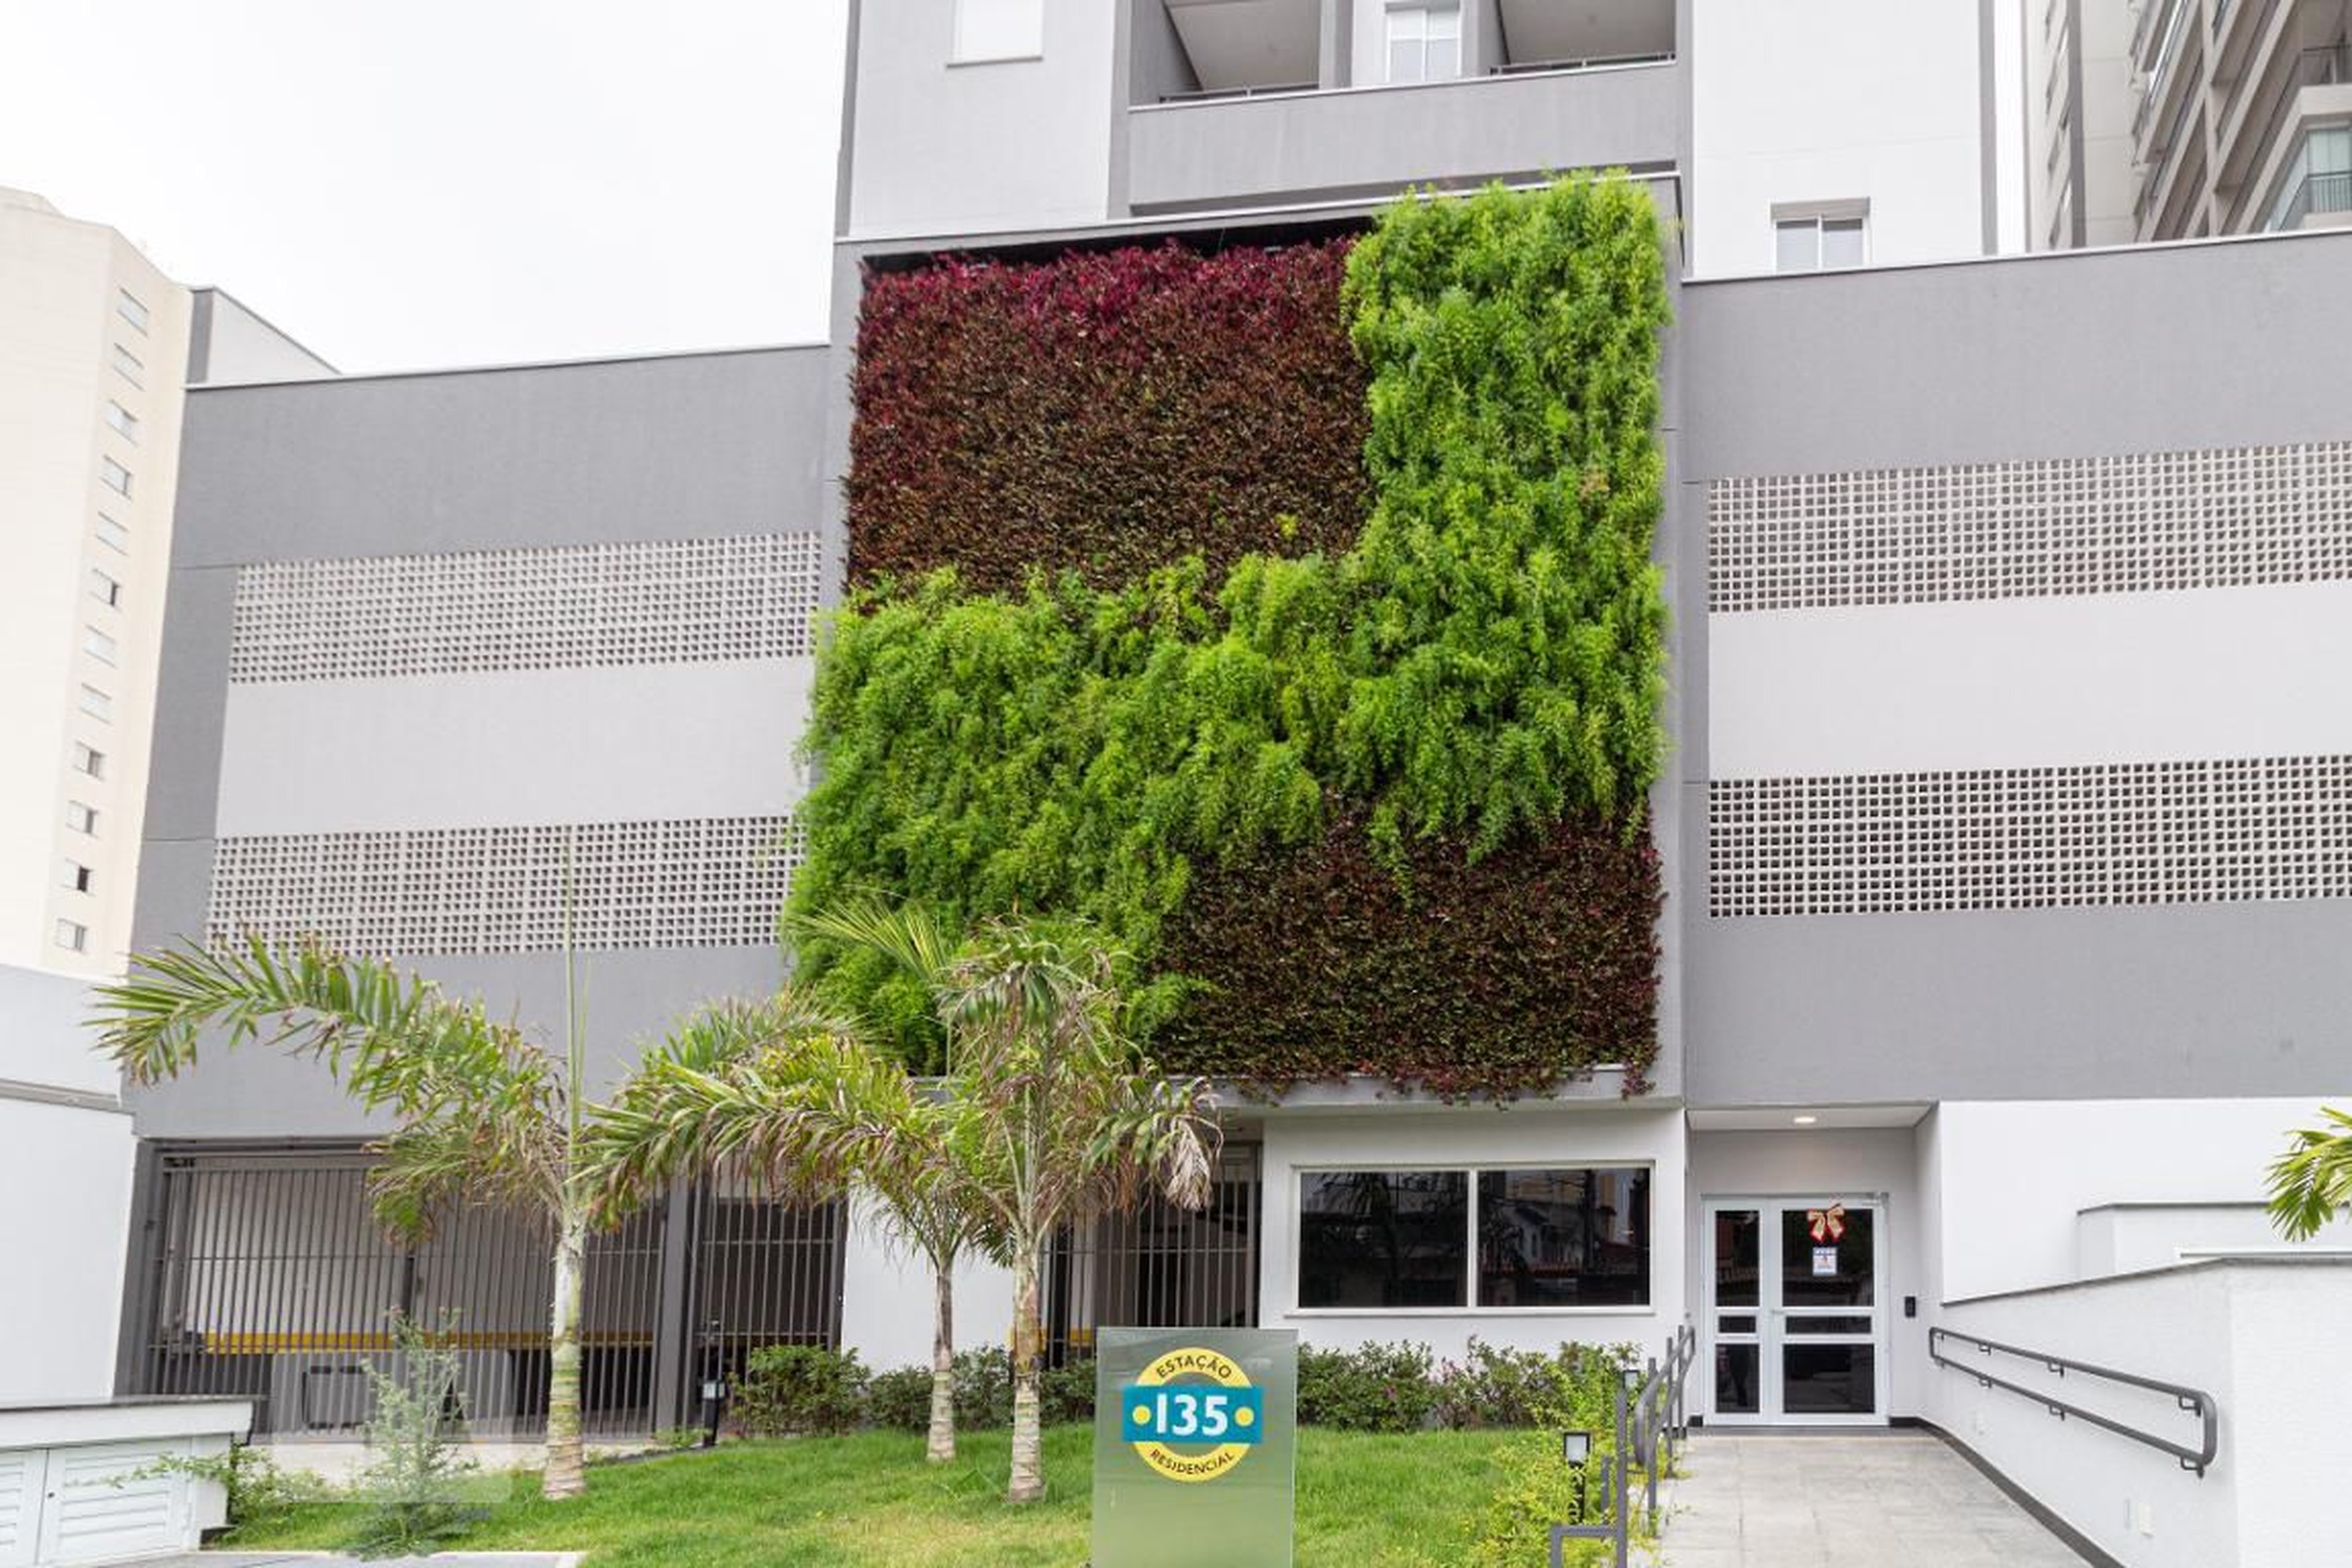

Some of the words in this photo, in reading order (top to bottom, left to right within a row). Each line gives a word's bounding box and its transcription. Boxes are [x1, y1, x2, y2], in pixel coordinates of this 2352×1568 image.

[1156, 1355, 1232, 1379] ESTAÇÃO
[1157, 1393, 1228, 1436] 135
[1150, 1449, 1234, 1474] RESIDENCIAL
